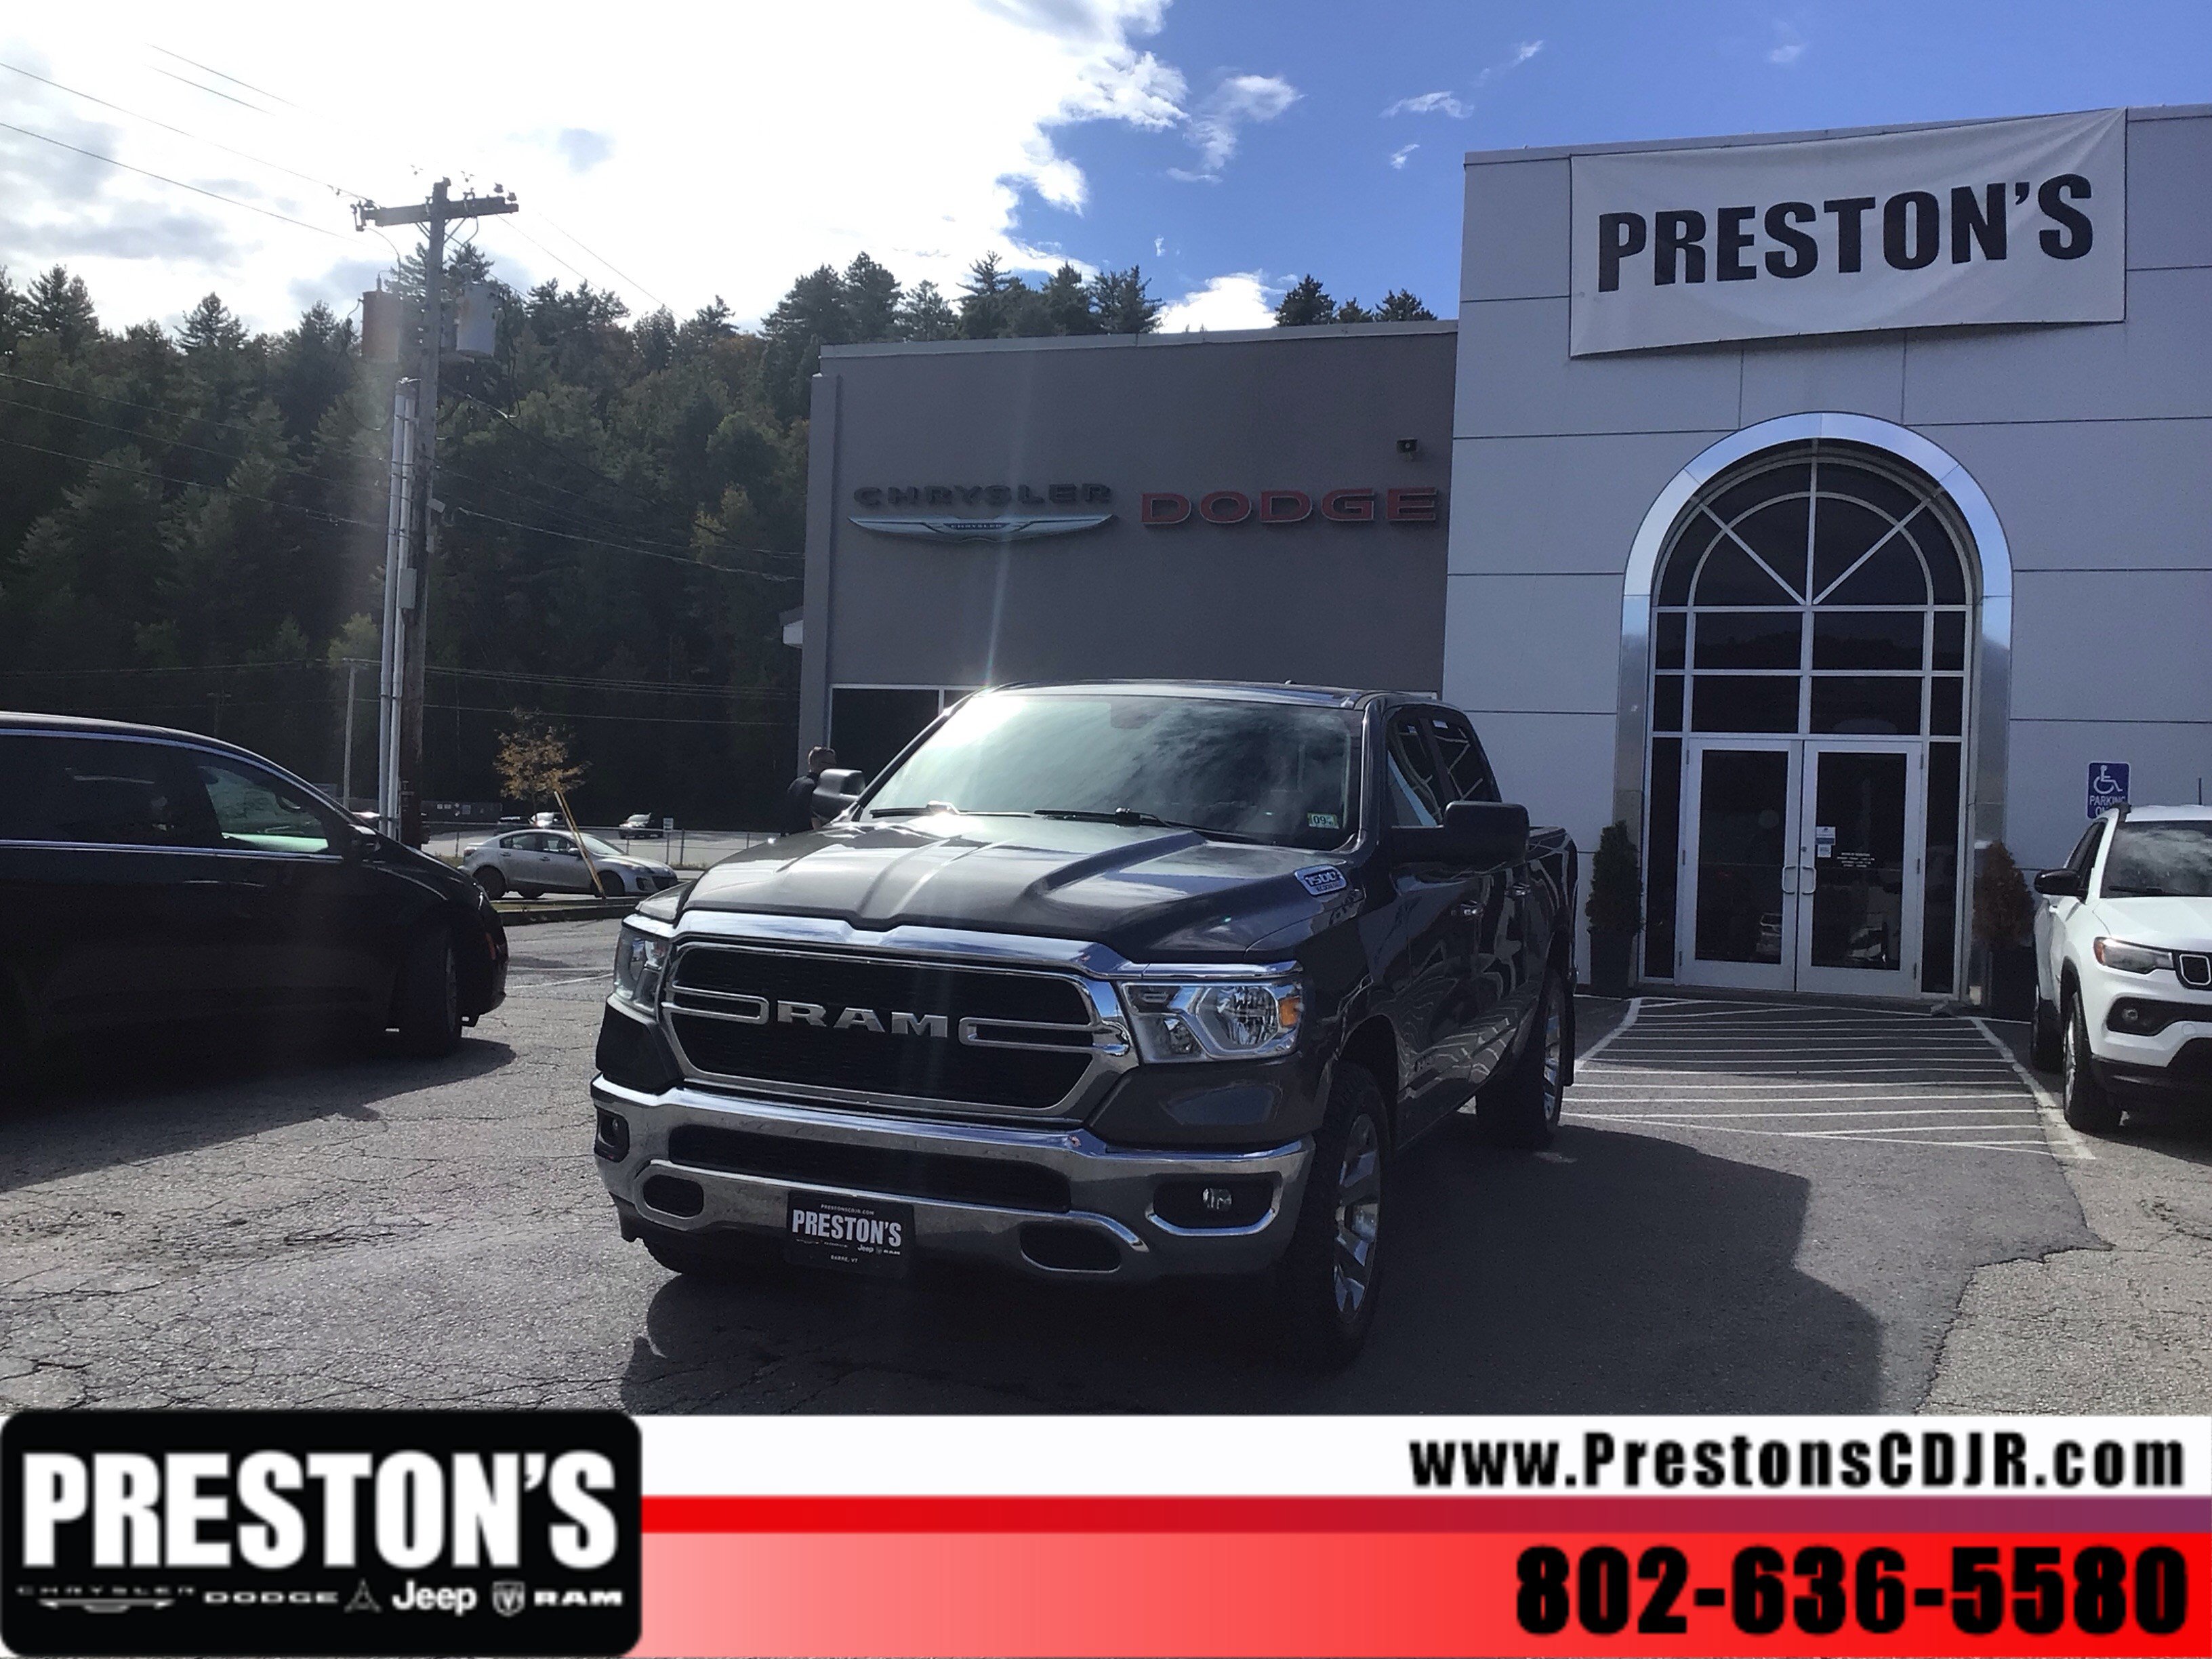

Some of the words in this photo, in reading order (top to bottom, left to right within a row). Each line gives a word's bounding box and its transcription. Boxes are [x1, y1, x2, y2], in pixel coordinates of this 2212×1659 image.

[1598, 173, 2093, 293] PRESTON'S
[854, 483, 1113, 507] CHRYSLER
[1141, 487, 1437, 525] DODGE
[1305, 871, 1337, 886] 1500
[777, 1000, 948, 1038] RAM
[792, 1209, 901, 1247] PRESTON'S
[857, 1244, 874, 1254] Jeep
